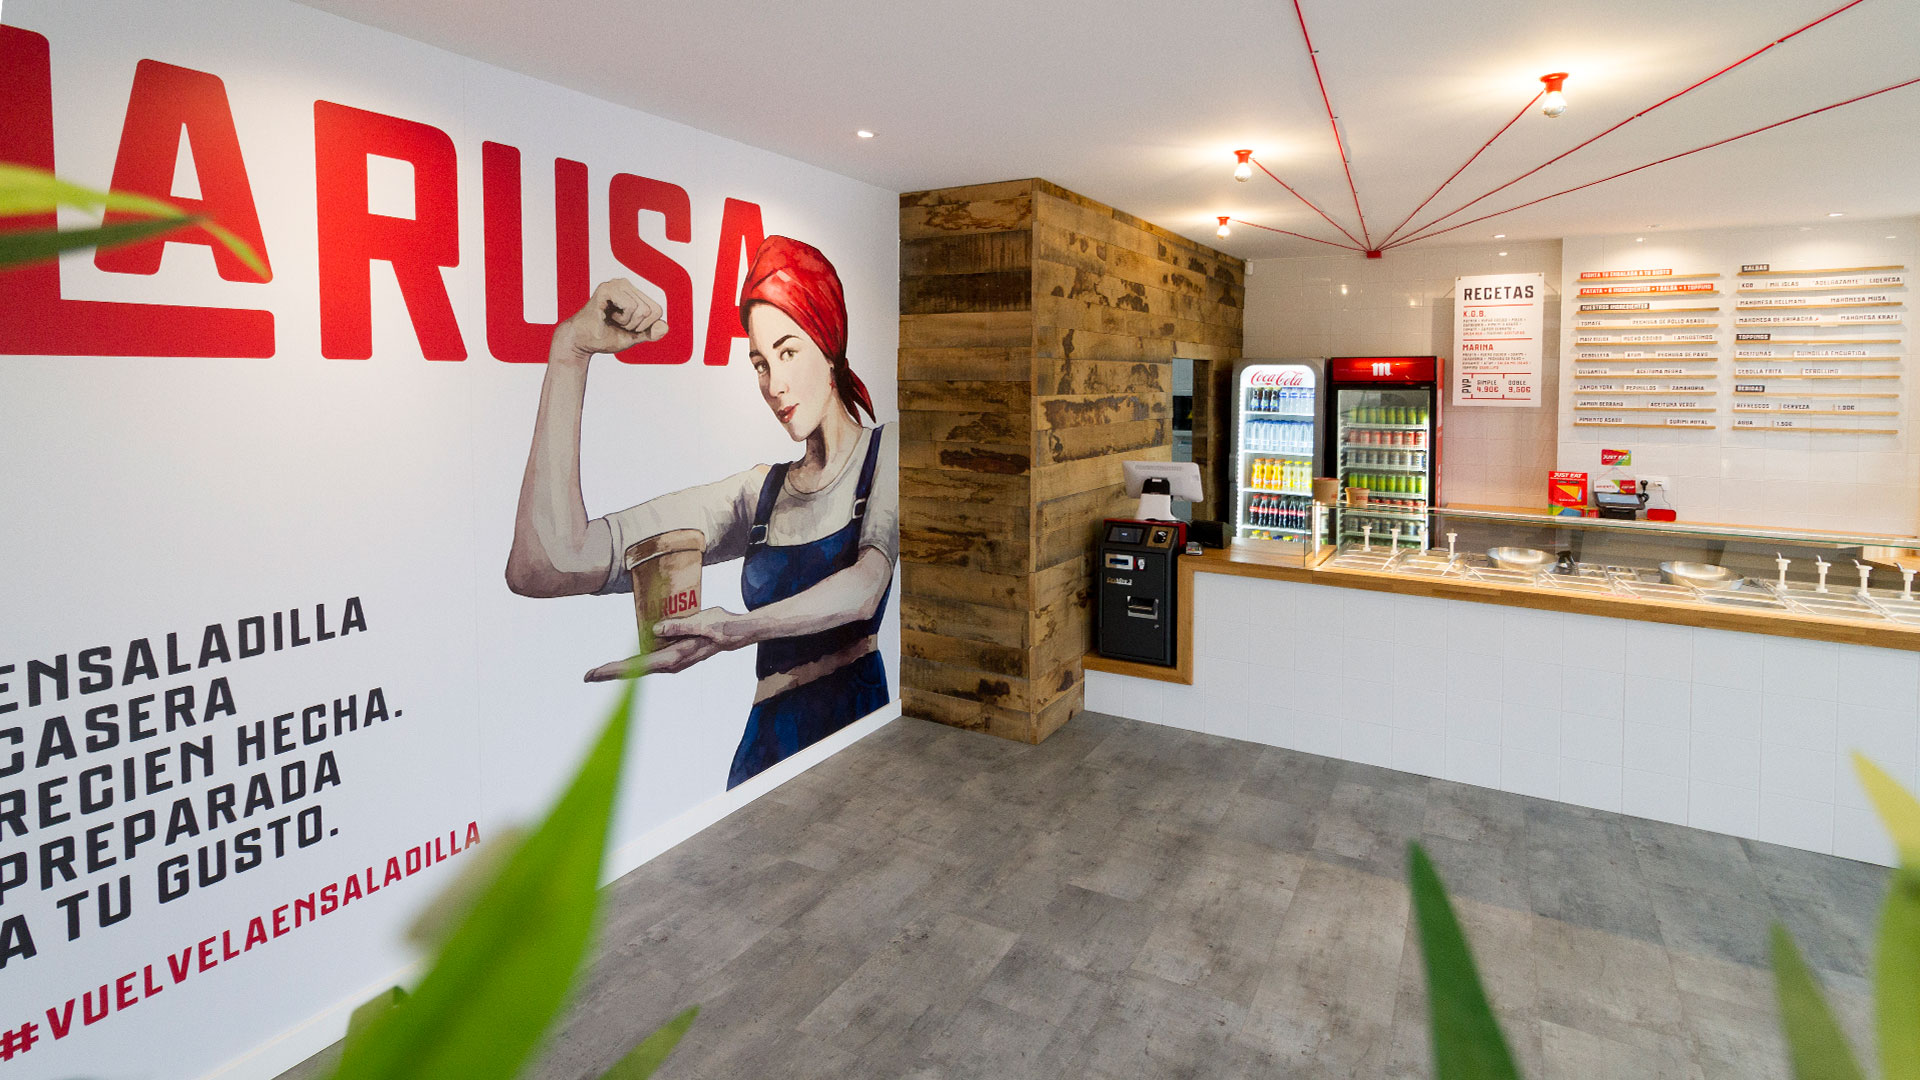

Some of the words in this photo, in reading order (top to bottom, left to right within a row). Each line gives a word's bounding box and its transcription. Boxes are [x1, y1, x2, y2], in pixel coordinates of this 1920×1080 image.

[1462, 343, 1494, 351] MARINA
[1463, 285, 1534, 301] RECETAS
[1461, 378, 1472, 394] PVP
[0, 676, 237, 779] CASERA
[0, 735, 214, 843] RECIEN
[236, 686, 403, 767] HECHA.
[0, 750, 341, 906] PREPARADA
[0, 914, 38, 970] A
[56, 874, 132, 942] TU
[157, 804, 339, 904] GUSTO.
[0, 820, 482, 1061] #VUELVELAENSALADILLA
